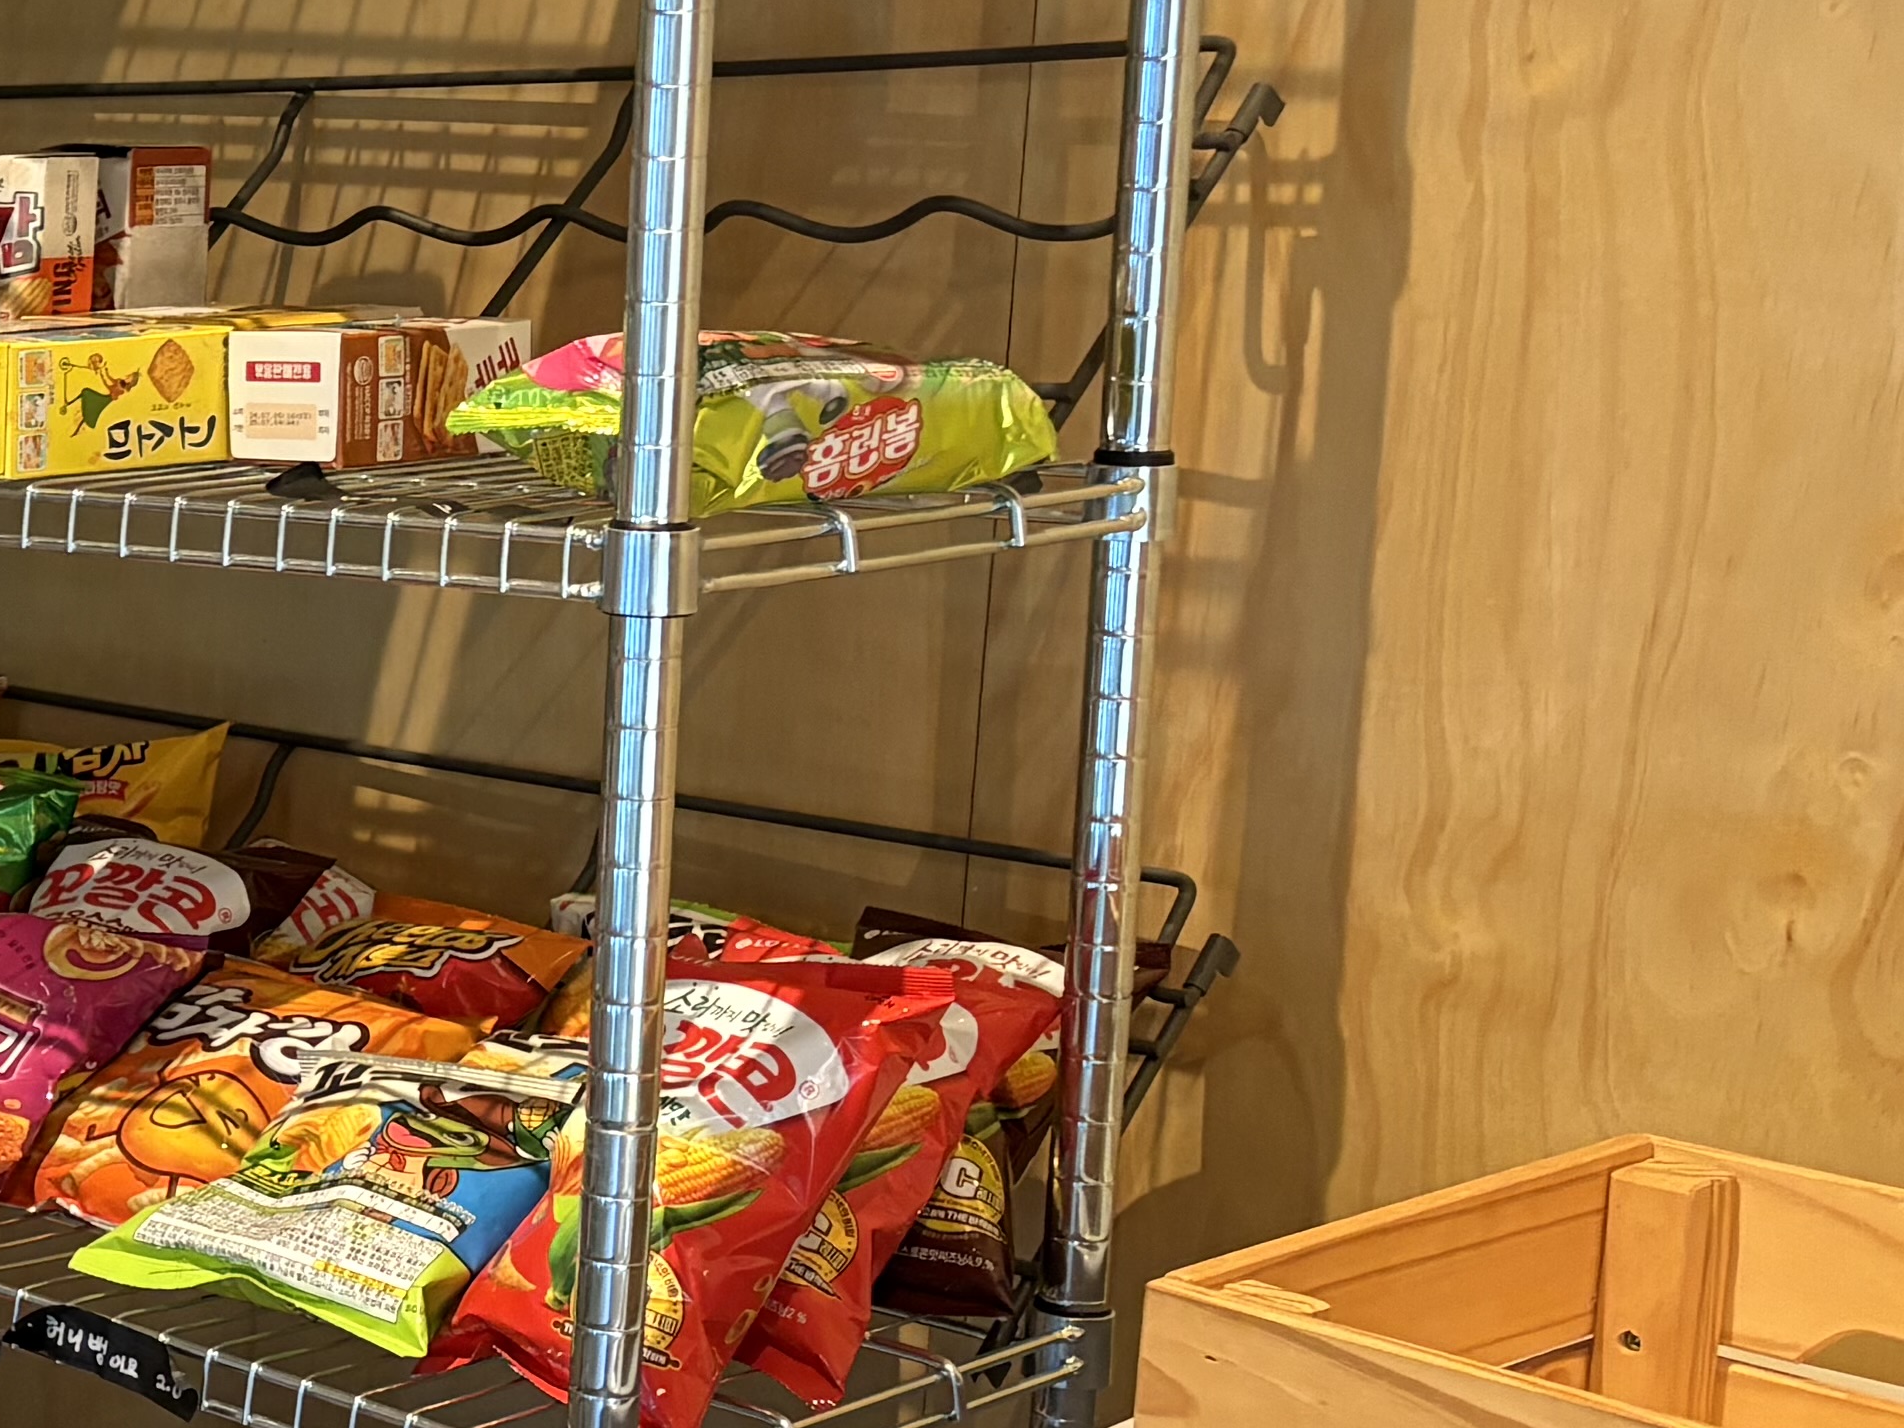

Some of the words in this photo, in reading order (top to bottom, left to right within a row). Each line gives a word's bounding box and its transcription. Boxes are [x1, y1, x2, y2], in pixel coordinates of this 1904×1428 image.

[803, 401, 921, 487] 홈런볼
[32, 861, 218, 934] 꼬깔콘
[297, 919, 496, 968] Cheetos
[661, 1020, 796, 1129] 깔콘
[156, 1374, 182, 1400] 2.0
